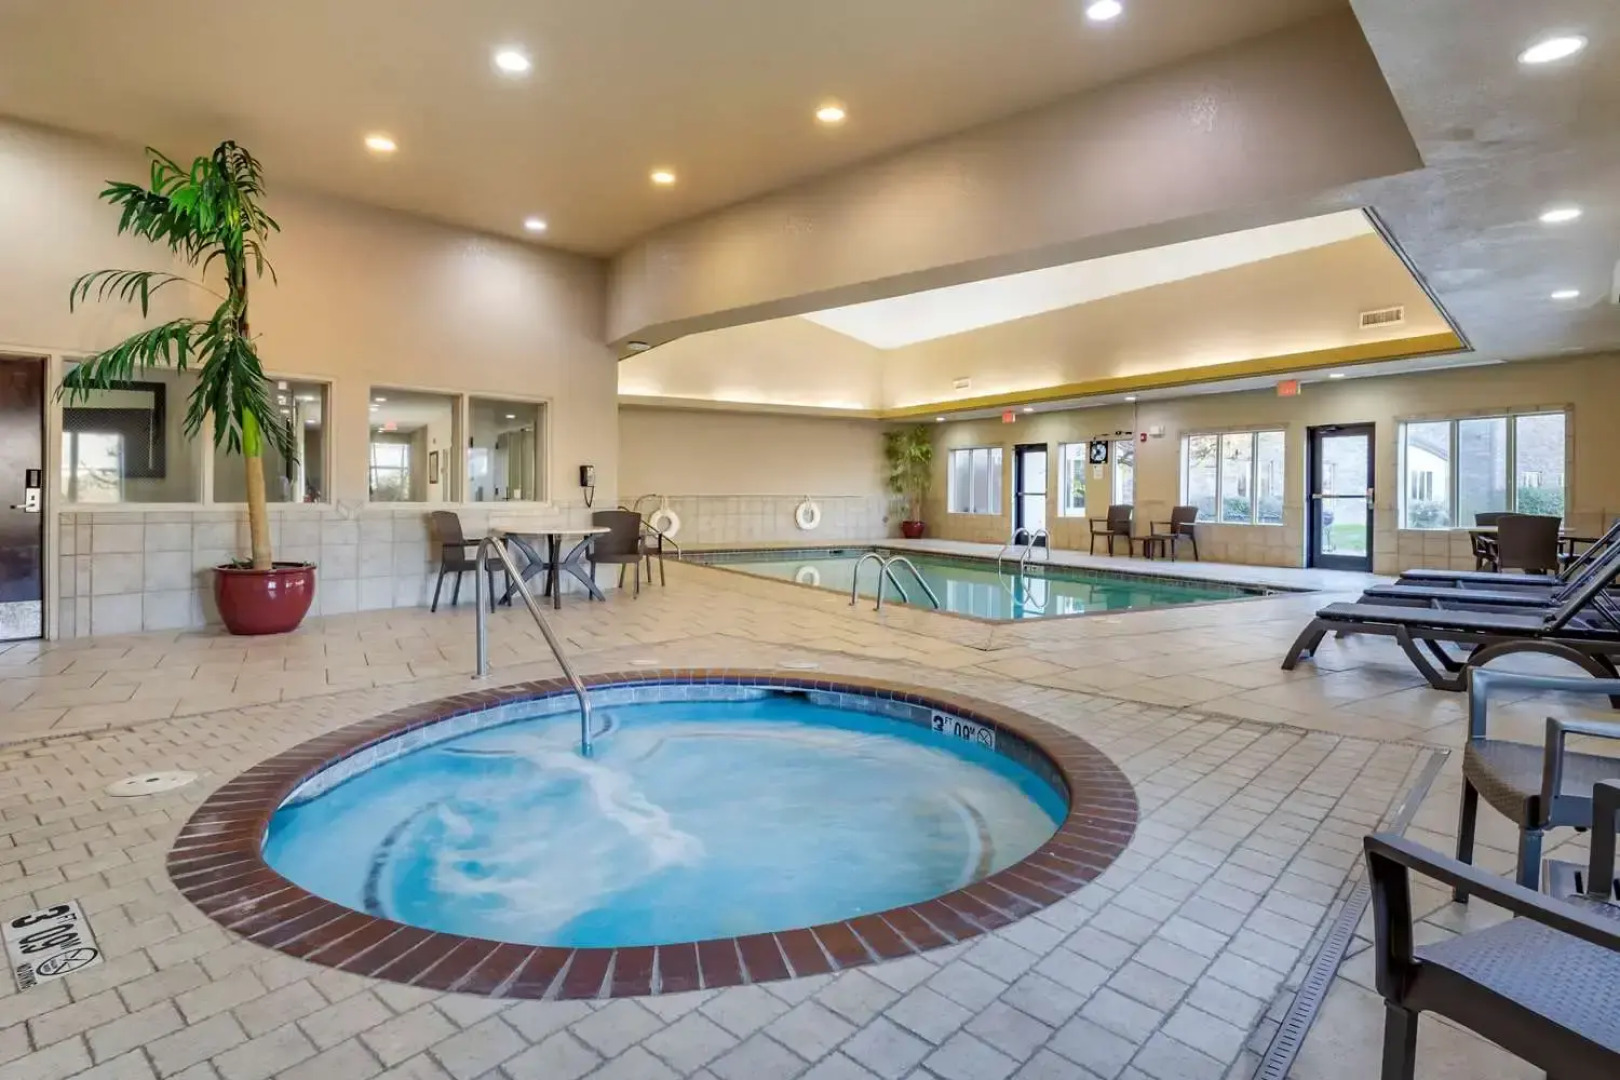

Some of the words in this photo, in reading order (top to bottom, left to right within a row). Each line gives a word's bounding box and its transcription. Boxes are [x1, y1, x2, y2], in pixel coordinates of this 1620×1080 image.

[933, 715, 944, 732] 3
[11, 904, 70, 928] 3
[18, 923, 79, 954] 0.9
